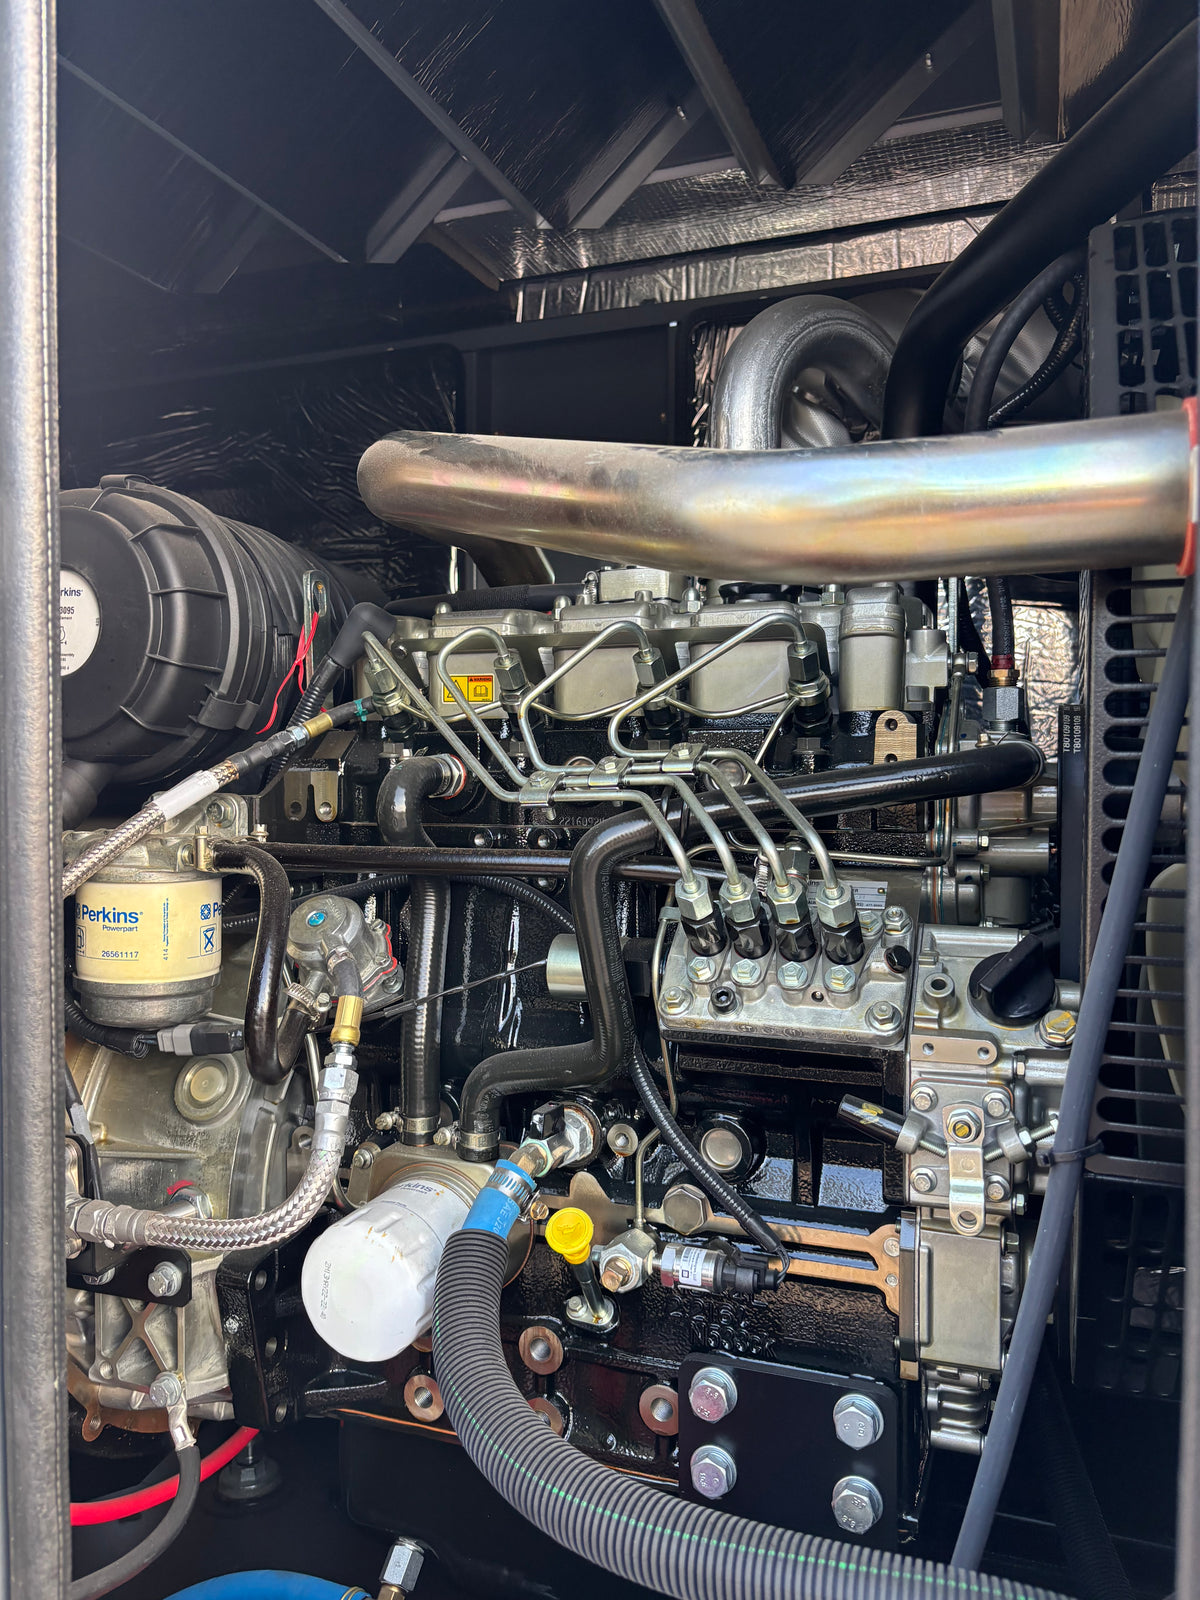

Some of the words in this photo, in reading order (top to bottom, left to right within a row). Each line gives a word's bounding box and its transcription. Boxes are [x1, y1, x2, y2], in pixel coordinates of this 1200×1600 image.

[82, 904, 139, 923] Perkins
[102, 925, 138, 933] Powerpart
[101, 950, 139, 958] 26561117
